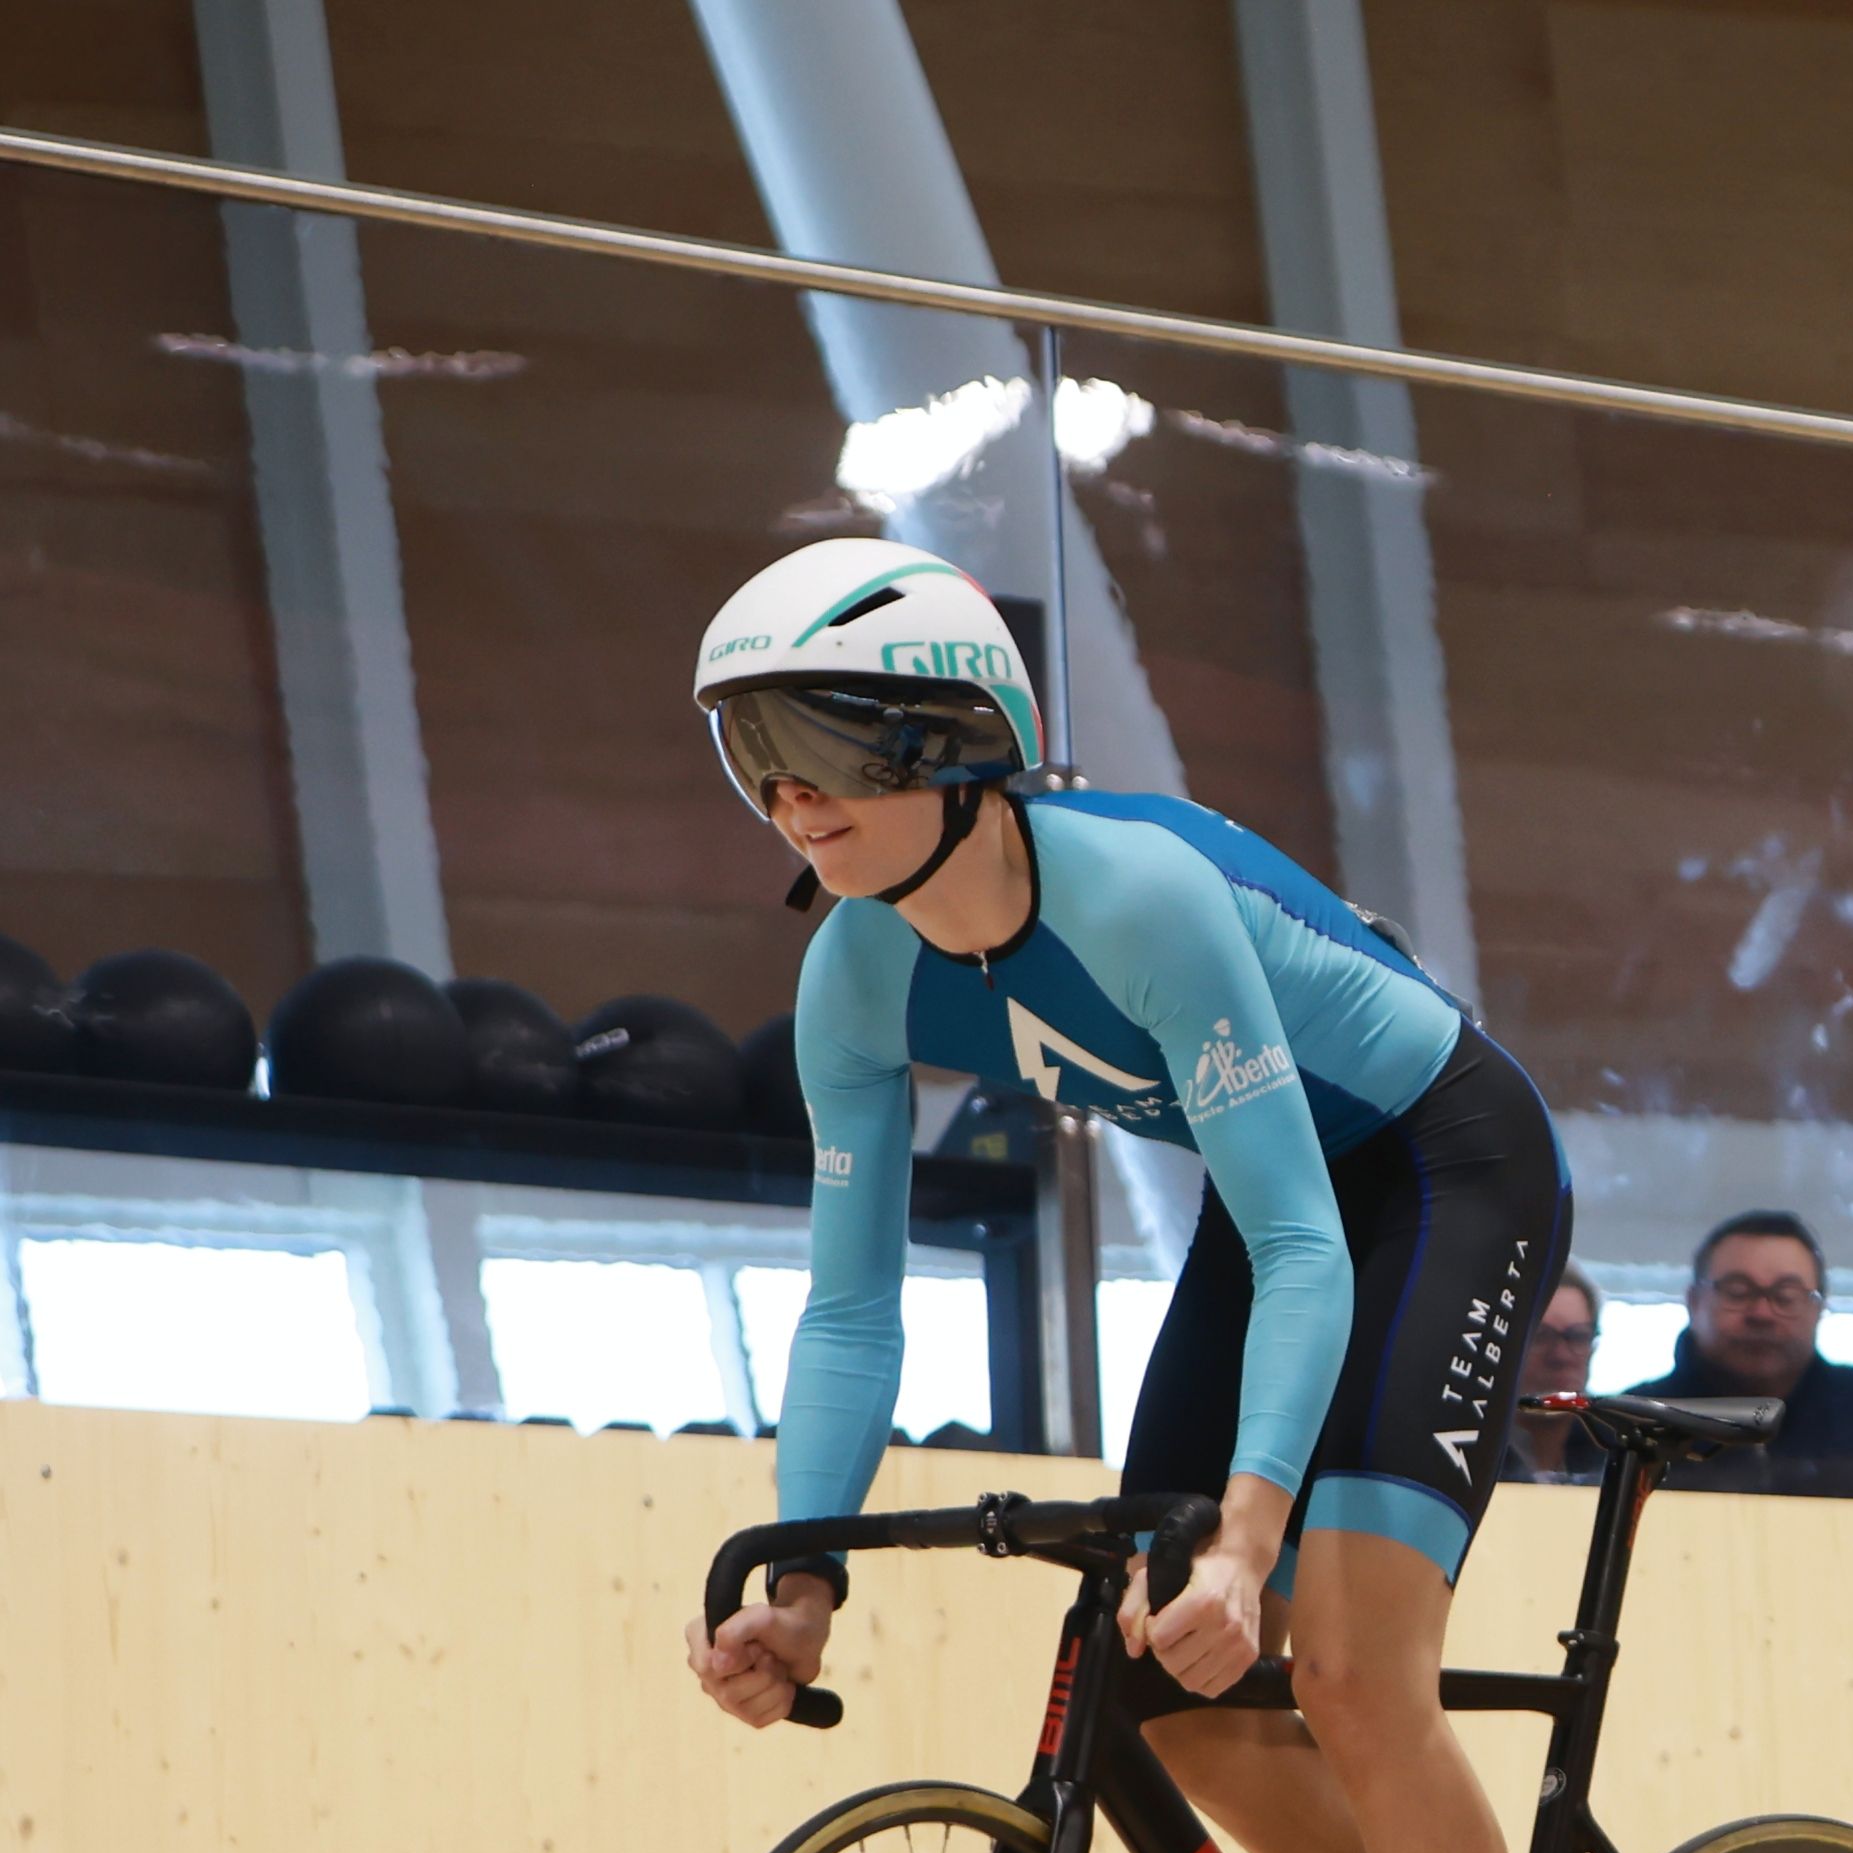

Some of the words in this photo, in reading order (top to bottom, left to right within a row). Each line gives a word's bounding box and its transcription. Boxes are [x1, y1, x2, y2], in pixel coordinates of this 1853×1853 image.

[708, 635, 772, 663] GIRO
[880, 640, 1012, 680] GIRO
[1441, 1297, 1491, 1402] TEAM
[1472, 1239, 1529, 1420] ALBERTA
[1037, 1636, 1082, 1756] BMC
